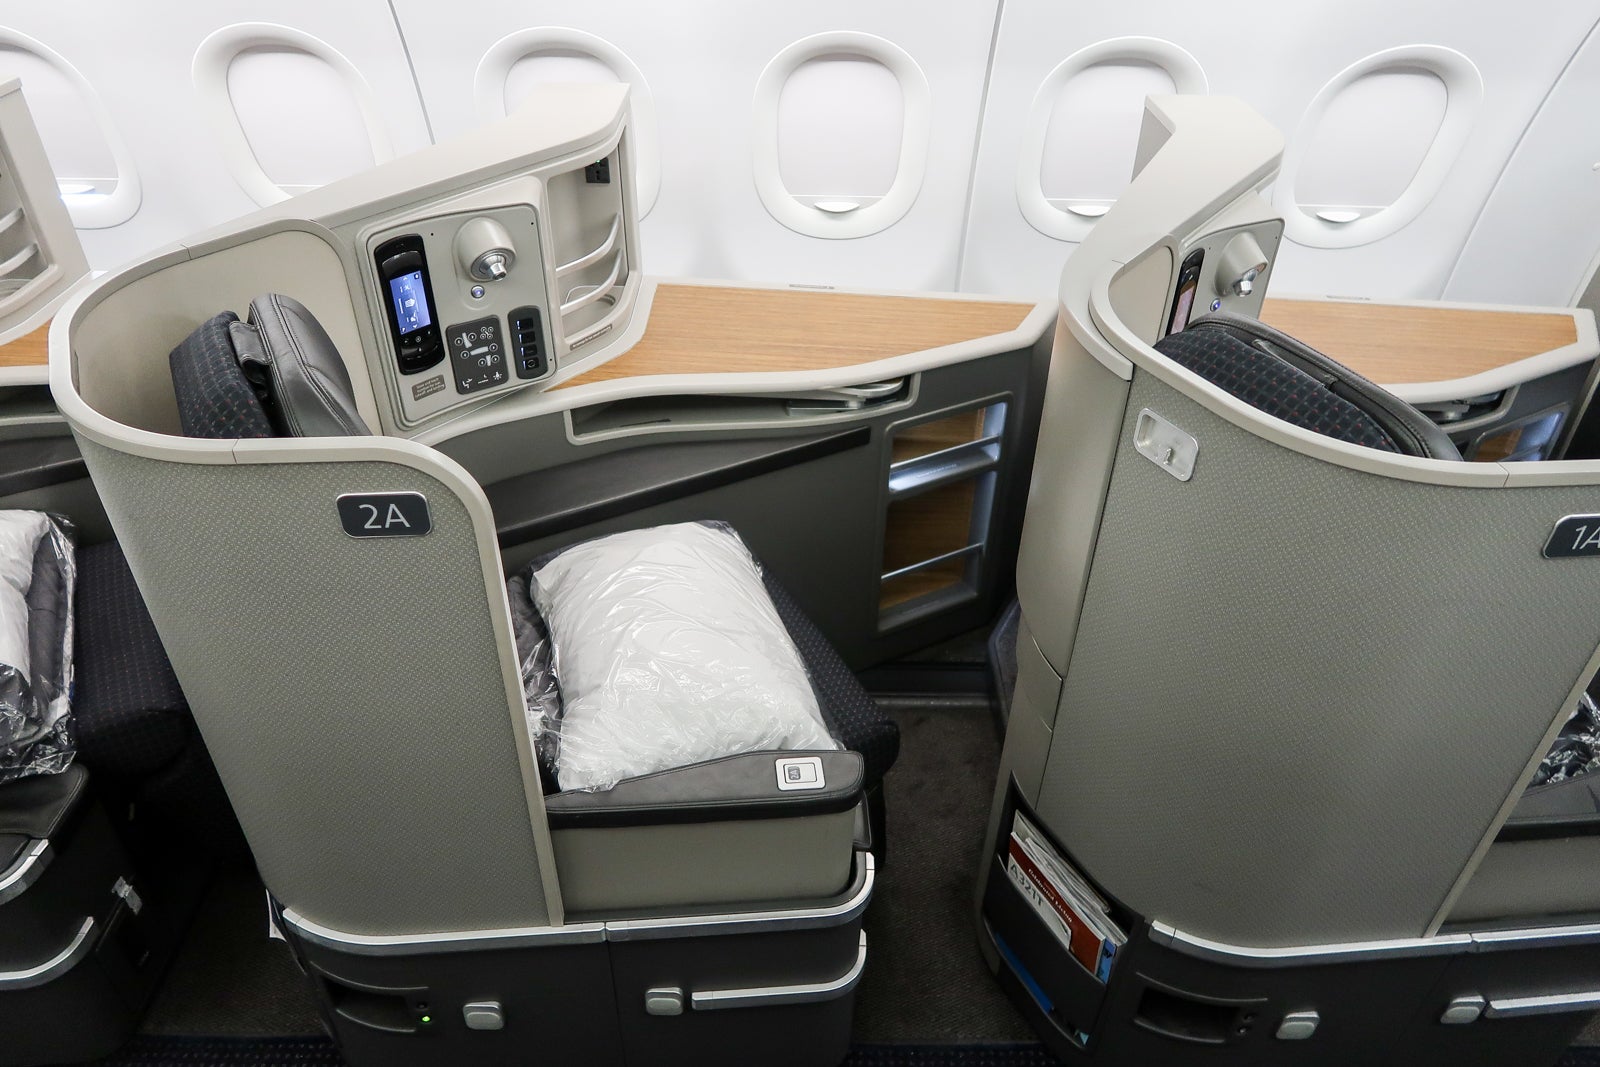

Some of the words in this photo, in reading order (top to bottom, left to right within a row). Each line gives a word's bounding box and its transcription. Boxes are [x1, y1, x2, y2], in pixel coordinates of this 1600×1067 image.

[358, 503, 411, 529] 2A
[1571, 525, 1600, 550] 1A
[1010, 864, 1043, 906] A321T
